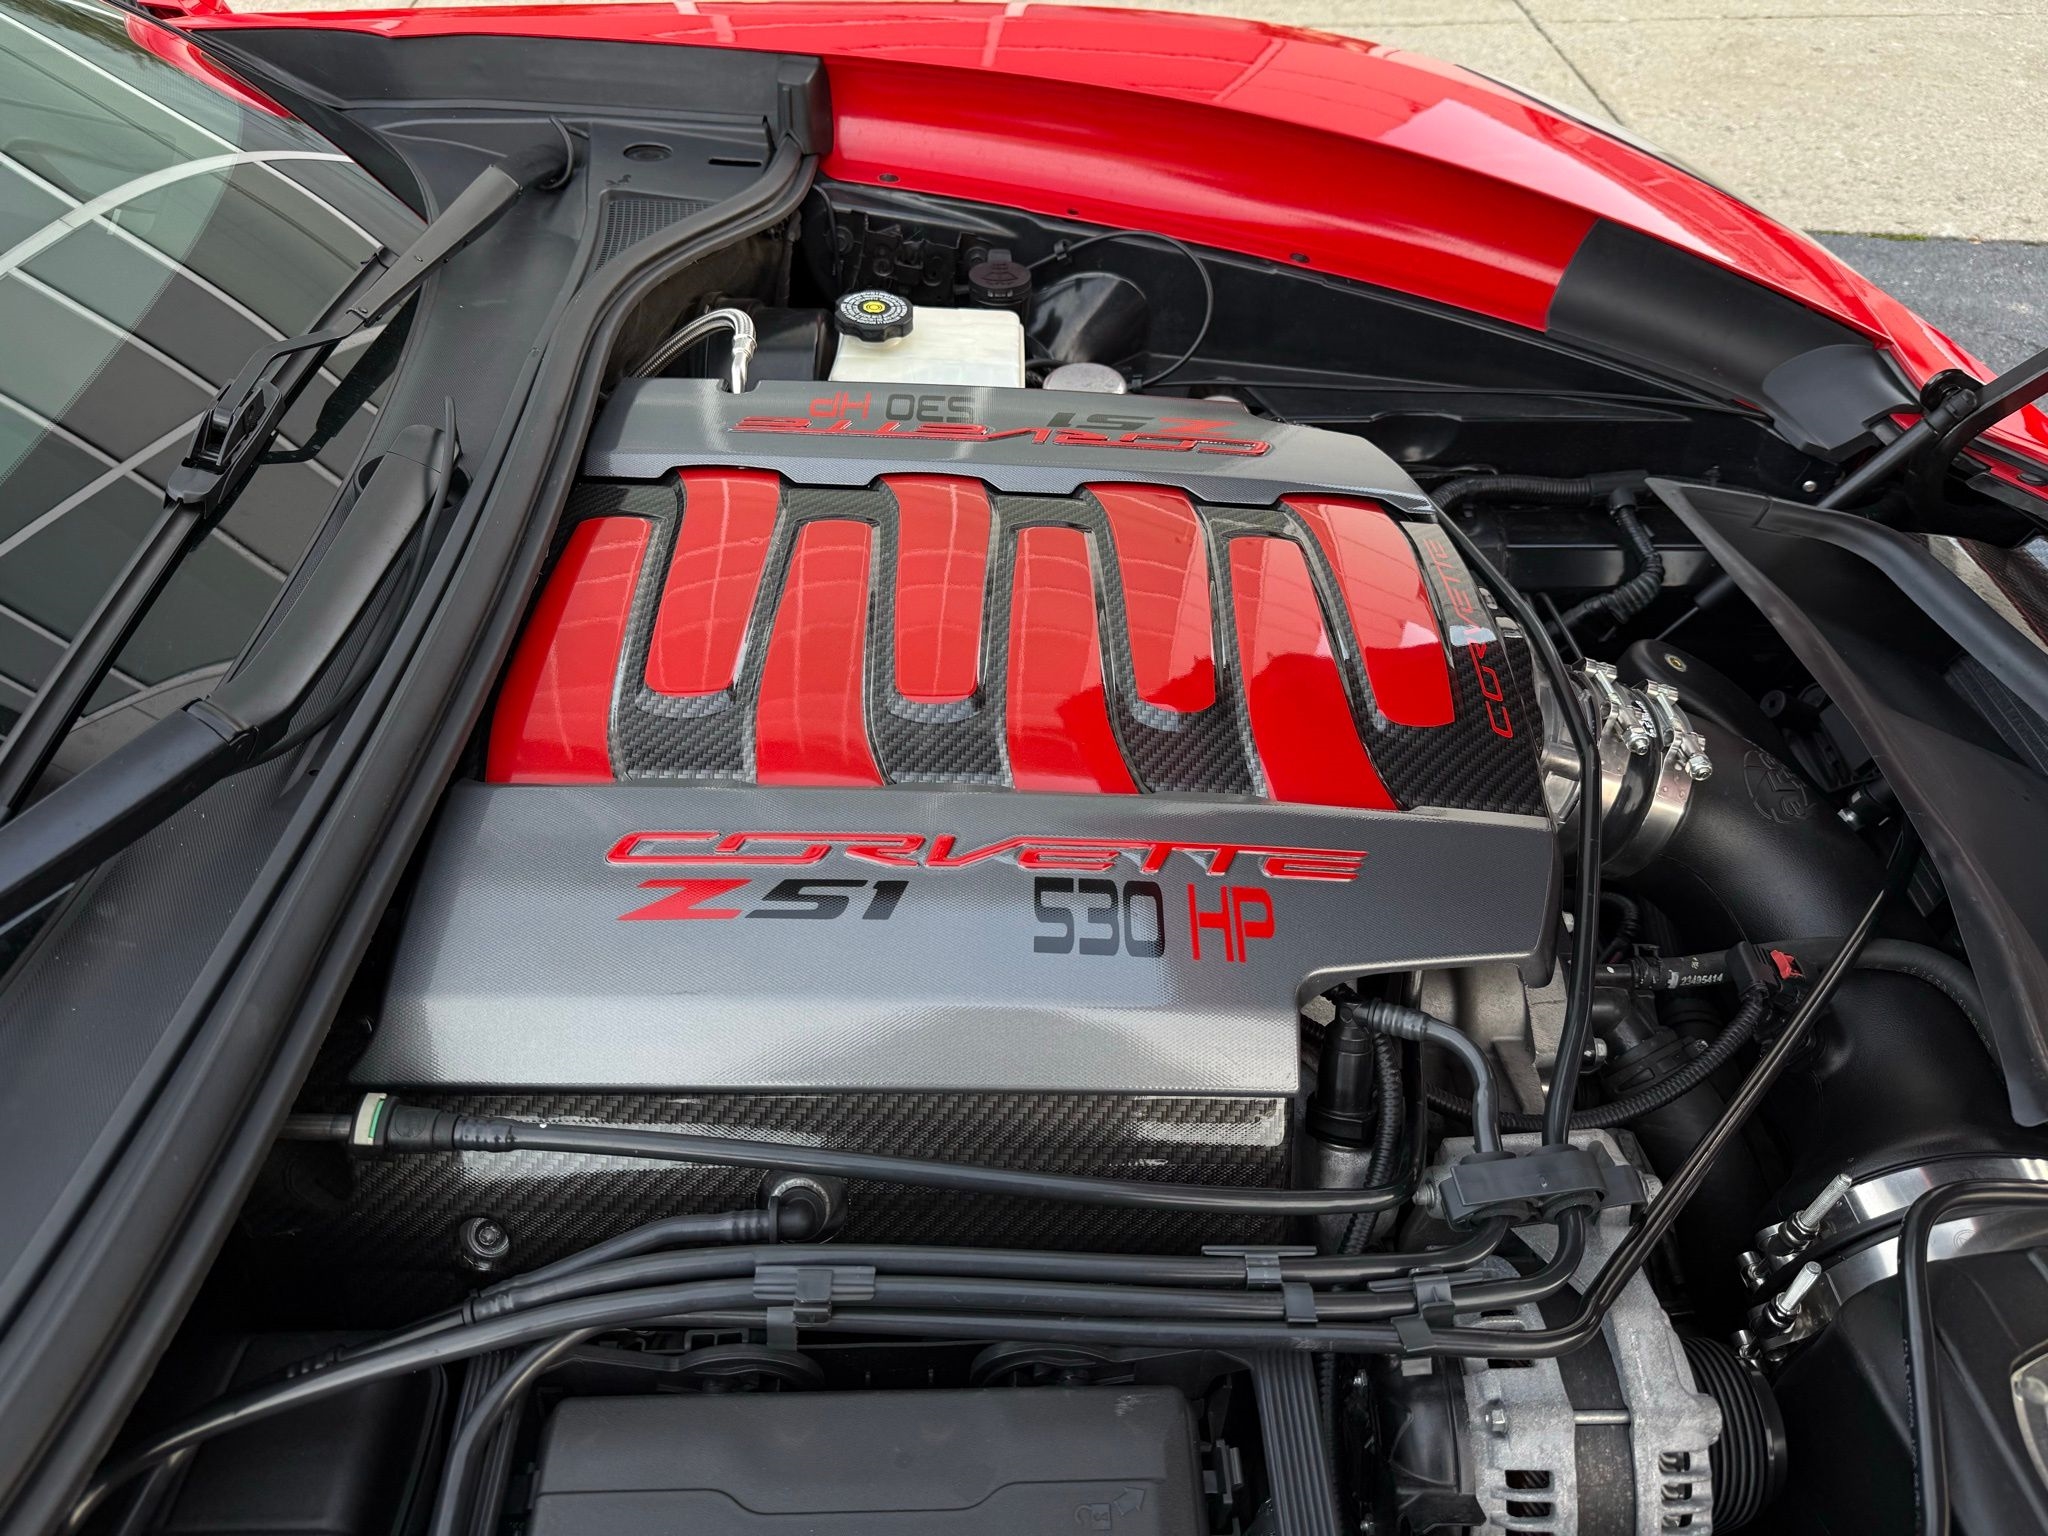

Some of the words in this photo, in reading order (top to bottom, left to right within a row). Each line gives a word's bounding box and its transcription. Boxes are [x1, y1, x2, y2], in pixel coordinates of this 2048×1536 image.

[808, 391, 871, 420] HP
[885, 394, 974, 422] 530
[1050, 411, 1234, 435] Z51
[728, 415, 1272, 457] CORVETTE
[606, 831, 1368, 881] CORVETTE
[617, 878, 909, 921] Z51
[1033, 877, 1166, 958] 530
[1187, 884, 1275, 963] HP
